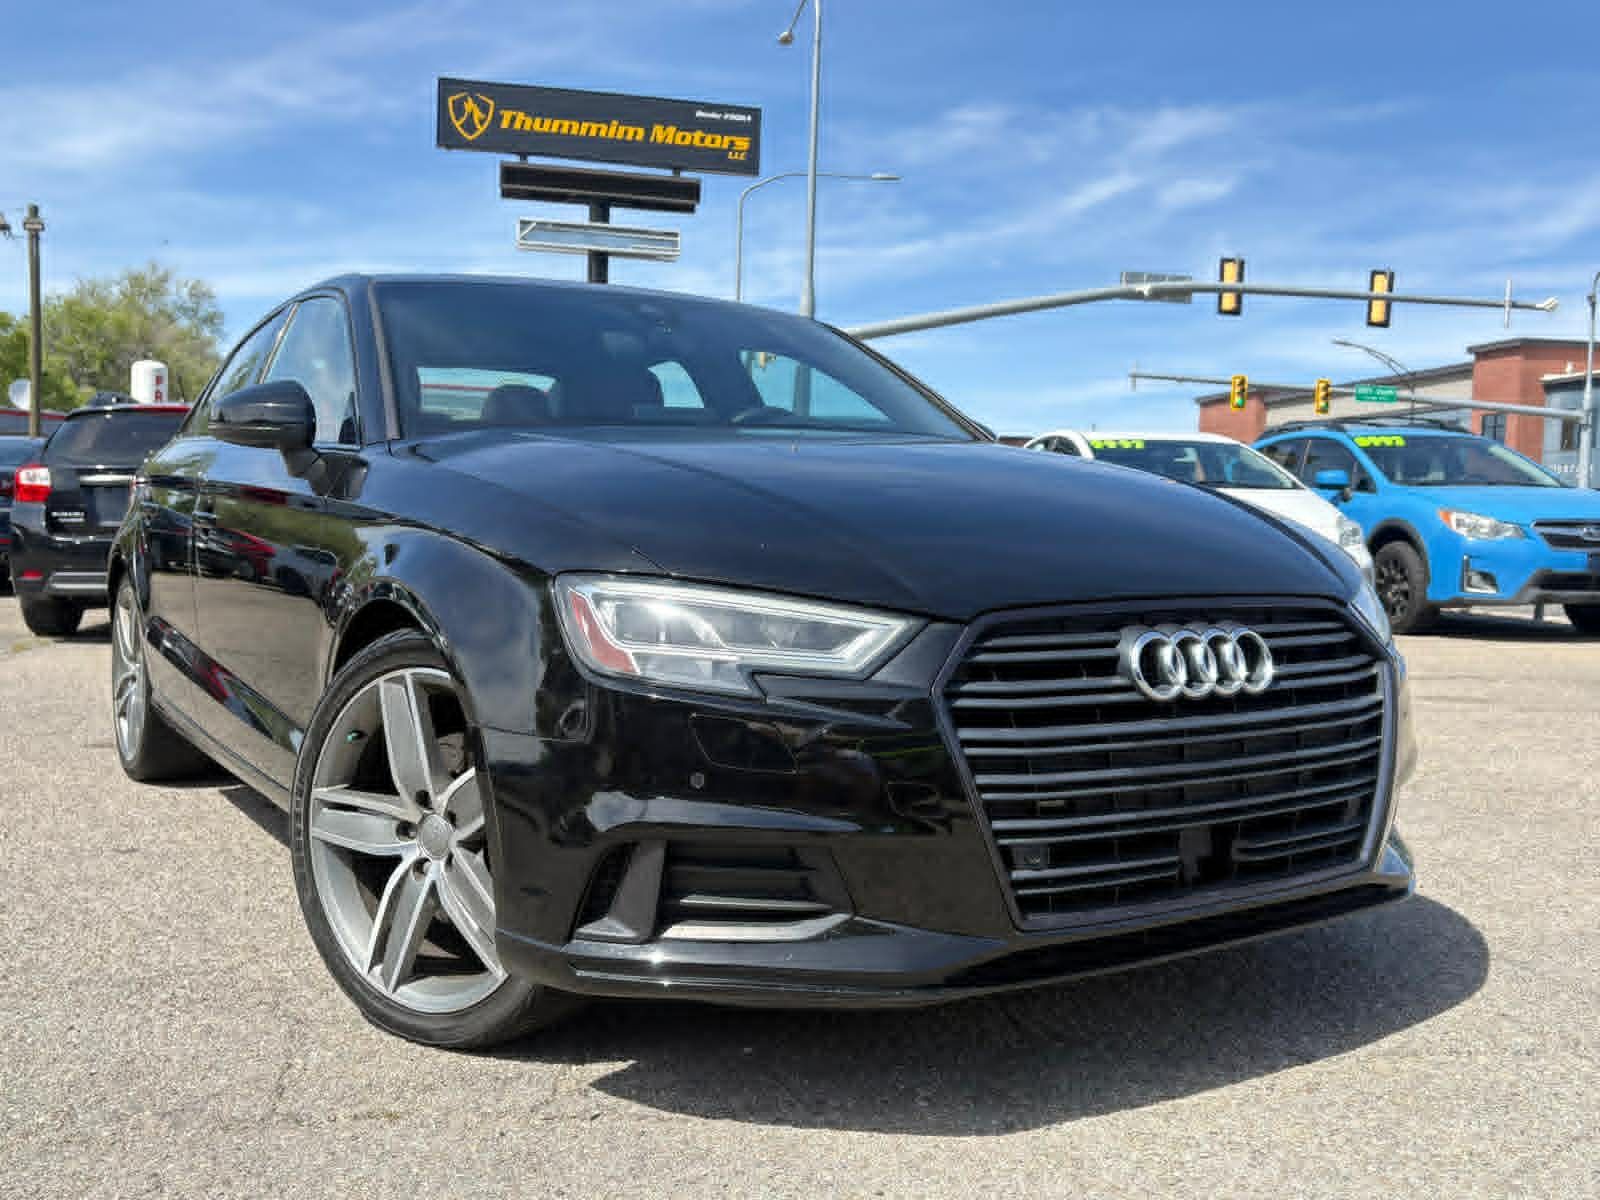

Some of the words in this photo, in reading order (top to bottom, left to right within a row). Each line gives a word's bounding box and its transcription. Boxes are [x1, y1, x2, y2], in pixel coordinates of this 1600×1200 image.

[499, 109, 645, 142] Thummim
[650, 123, 752, 151] Motors
[727, 151, 746, 161] LLC
